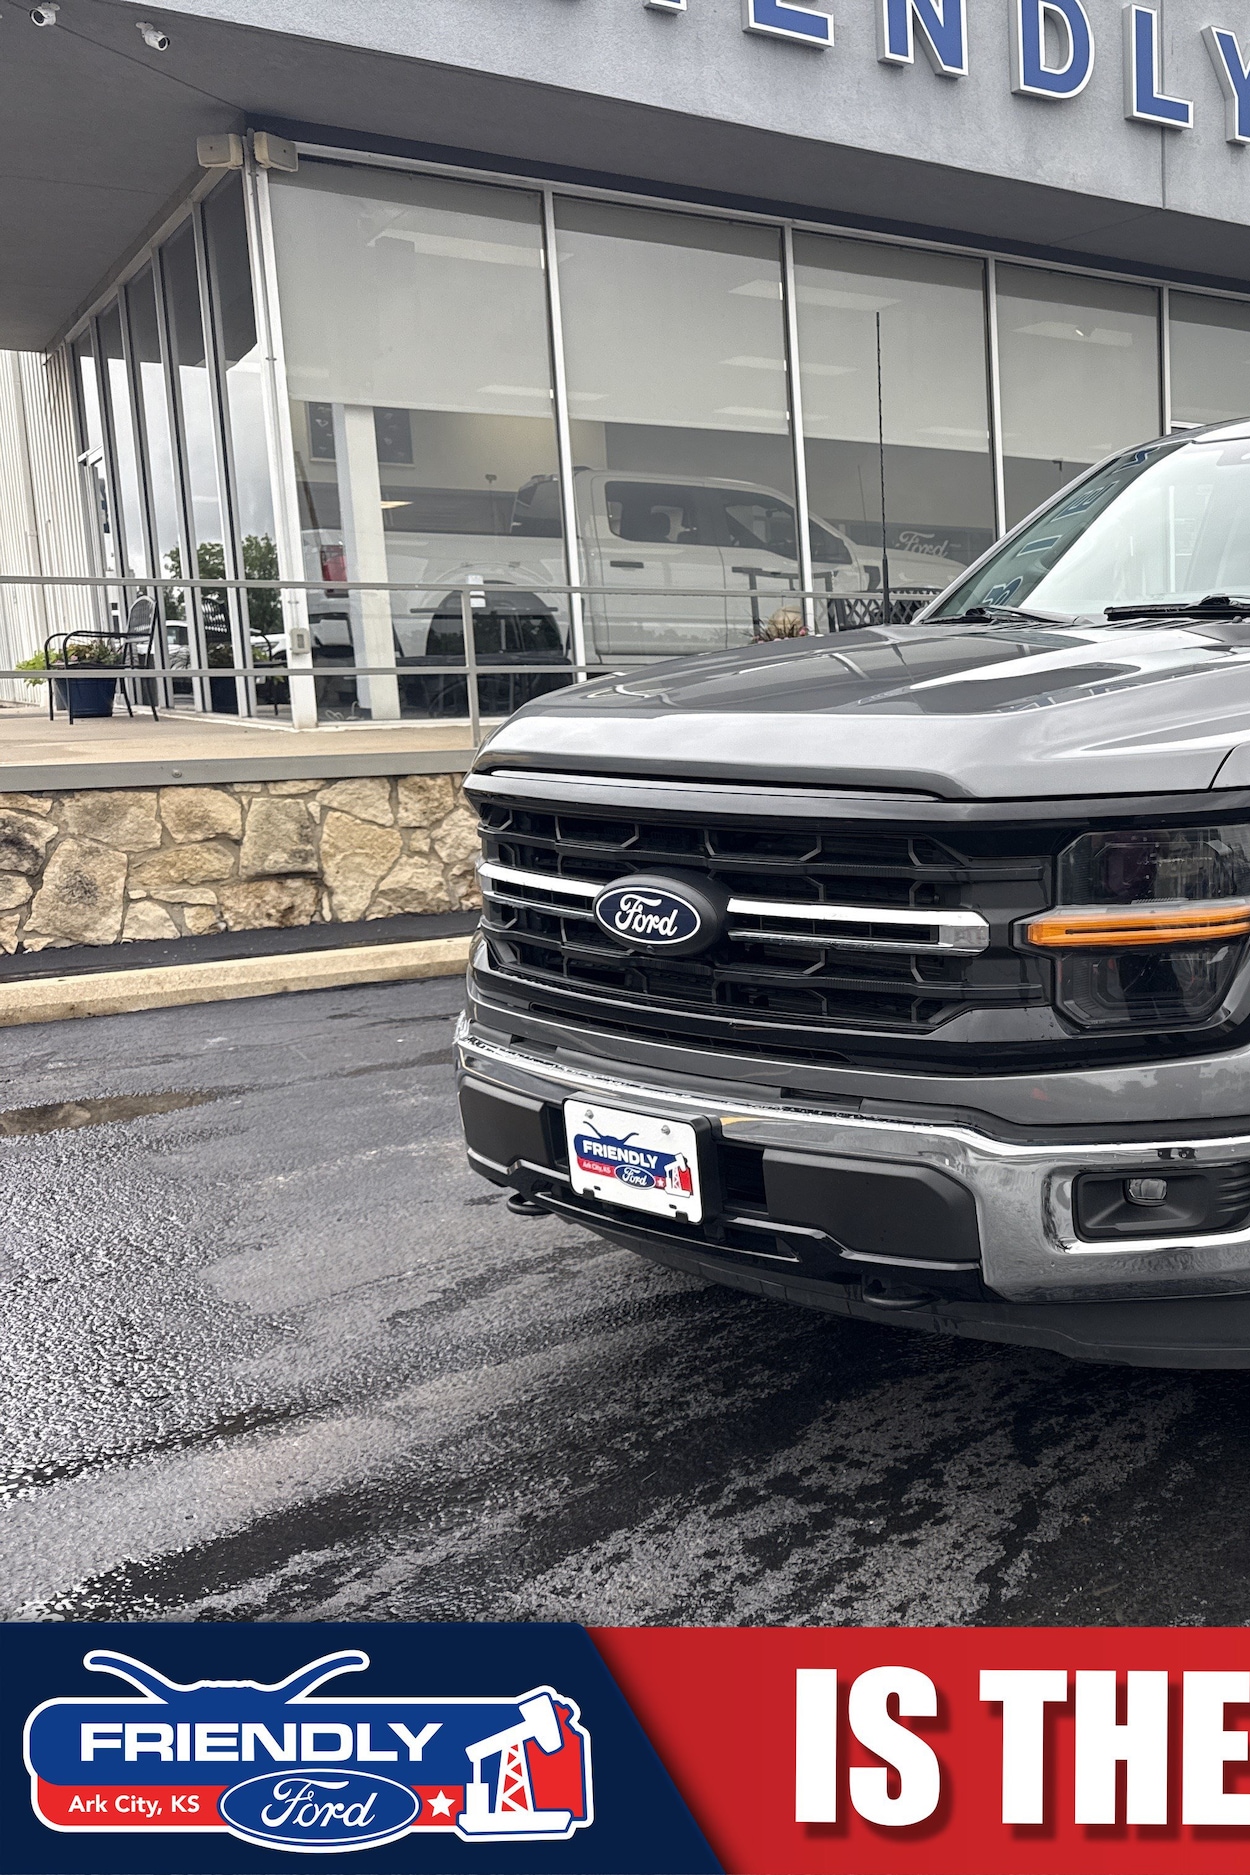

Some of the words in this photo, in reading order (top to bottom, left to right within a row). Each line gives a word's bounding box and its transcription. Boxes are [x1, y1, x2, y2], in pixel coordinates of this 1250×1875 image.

[895, 531, 949, 558] Ford
[614, 893, 679, 937] Ford
[582, 1140, 658, 1169] FRIENDLY
[622, 1167, 647, 1186] Ford
